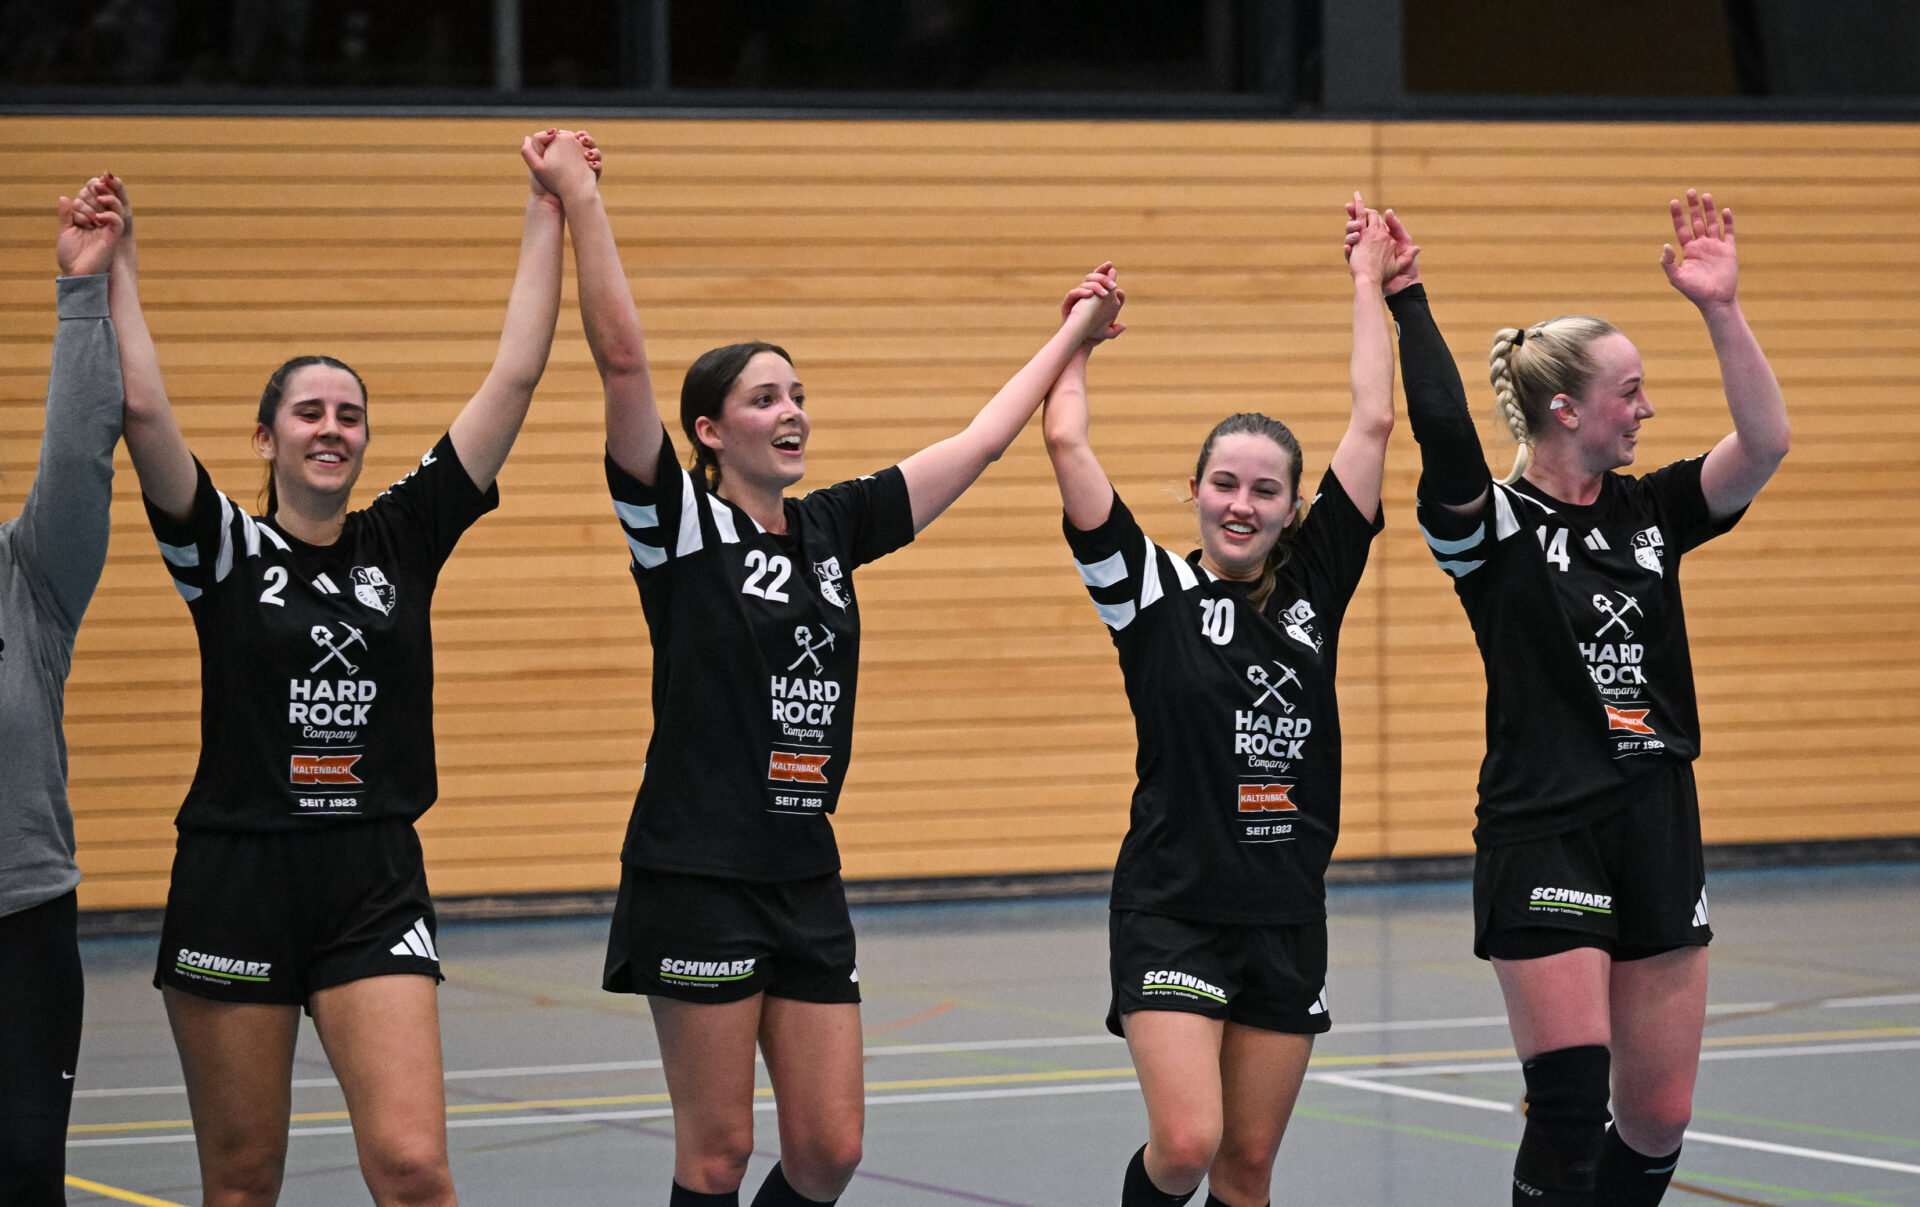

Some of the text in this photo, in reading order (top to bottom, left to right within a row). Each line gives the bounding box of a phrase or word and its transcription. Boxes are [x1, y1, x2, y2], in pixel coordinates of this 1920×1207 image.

[259, 566, 289, 607] 2
[741, 549, 792, 604] 22
[1199, 598, 1235, 646] 10
[1579, 642, 1645, 664] HARD
[290, 679, 377, 702] HARD
[771, 675, 841, 702] HARD
[1597, 683, 1642, 699] Company
[289, 702, 372, 726] ROCK
[772, 698, 836, 726] ROCK
[303, 725, 358, 743] Company
[782, 722, 825, 743] Company
[1235, 710, 1312, 738] HARD
[1234, 732, 1306, 760] ROCK
[1617, 742, 1641, 751] SEIT
[293, 765, 349, 775] KALTENBACH
[771, 760, 820, 773] KALTENBACH
[1248, 754, 1291, 773] Company
[299, 798, 358, 808] SEIT 1923
[775, 796, 823, 808] SEIT 1923
[1240, 793, 1288, 803] KALTENBACH
[1246, 824, 1293, 836] SEIT 1923
[1530, 887, 1613, 909] SCHWARZ
[177, 948, 272, 977] SCHWARZ
[660, 958, 757, 977] SCHWARZ
[1143, 970, 1226, 999] SCHWARZ
